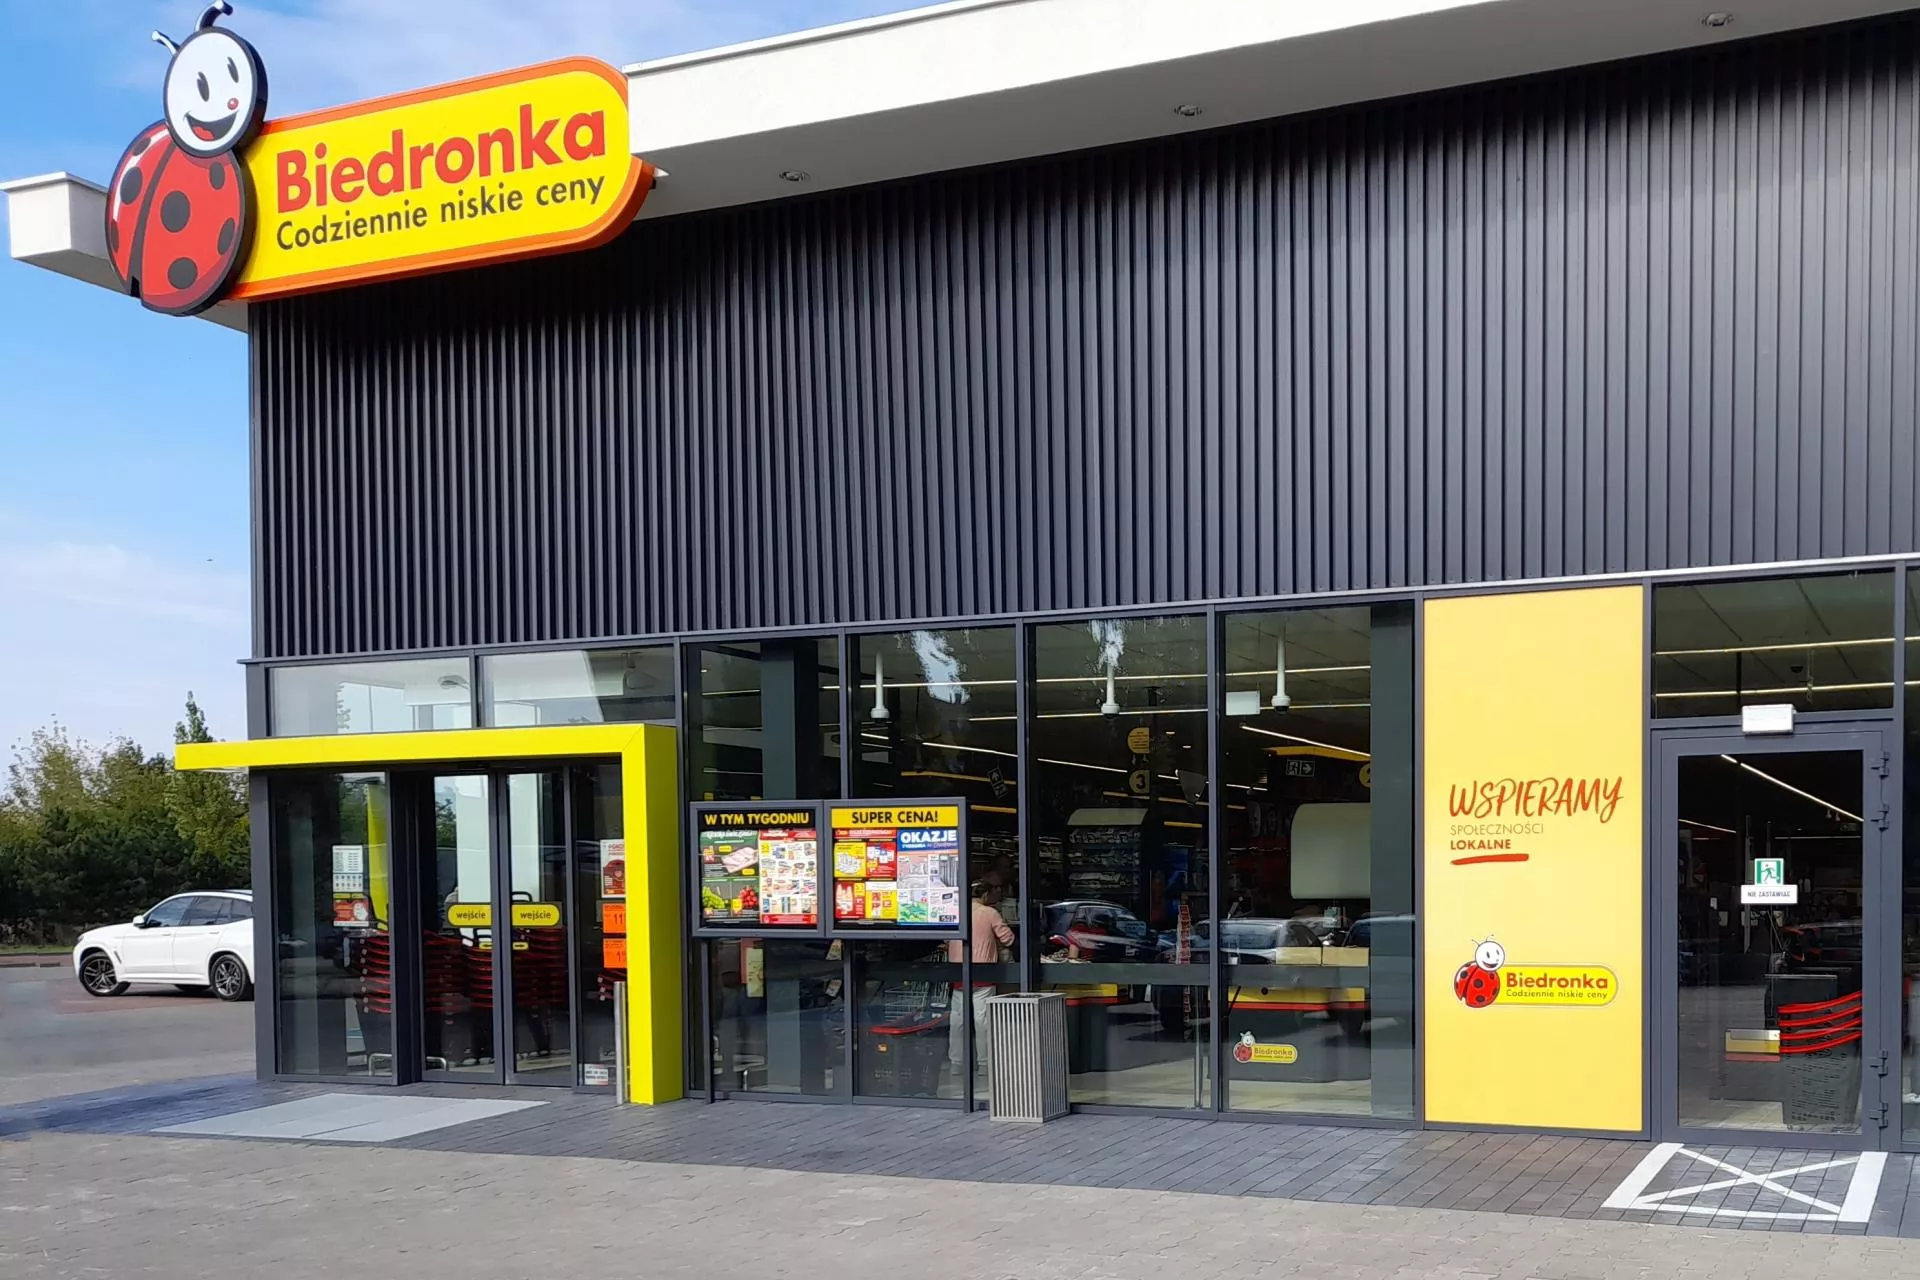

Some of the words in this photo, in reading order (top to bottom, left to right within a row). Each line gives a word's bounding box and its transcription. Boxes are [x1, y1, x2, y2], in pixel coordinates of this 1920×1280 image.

[277, 103, 606, 214] Biedronka
[276, 199, 428, 251] Codziennie
[440, 182, 524, 224] niskie
[536, 175, 606, 206] ceny
[1449, 776, 1624, 824] WSPIERAMY
[704, 814, 718, 825] W
[719, 813, 745, 825] TYM
[747, 812, 810, 825] TYGODNIU
[851, 811, 893, 824] SUPER
[897, 810, 939, 823] CENA!
[1449, 820, 1544, 836] SPOŁECZNOŚCI
[900, 829, 957, 844] OKAZJE
[1450, 838, 1512, 850] LOKALNE
[456, 910, 486, 920] wejście
[520, 910, 553, 920] wejście
[1506, 971, 1609, 989] Biedronka
[1506, 988, 1555, 998] Codziennie
[1558, 989, 1584, 998] niskie
[1587, 991, 1608, 1000] ceny
[1254, 1047, 1293, 1056] Biedronka
